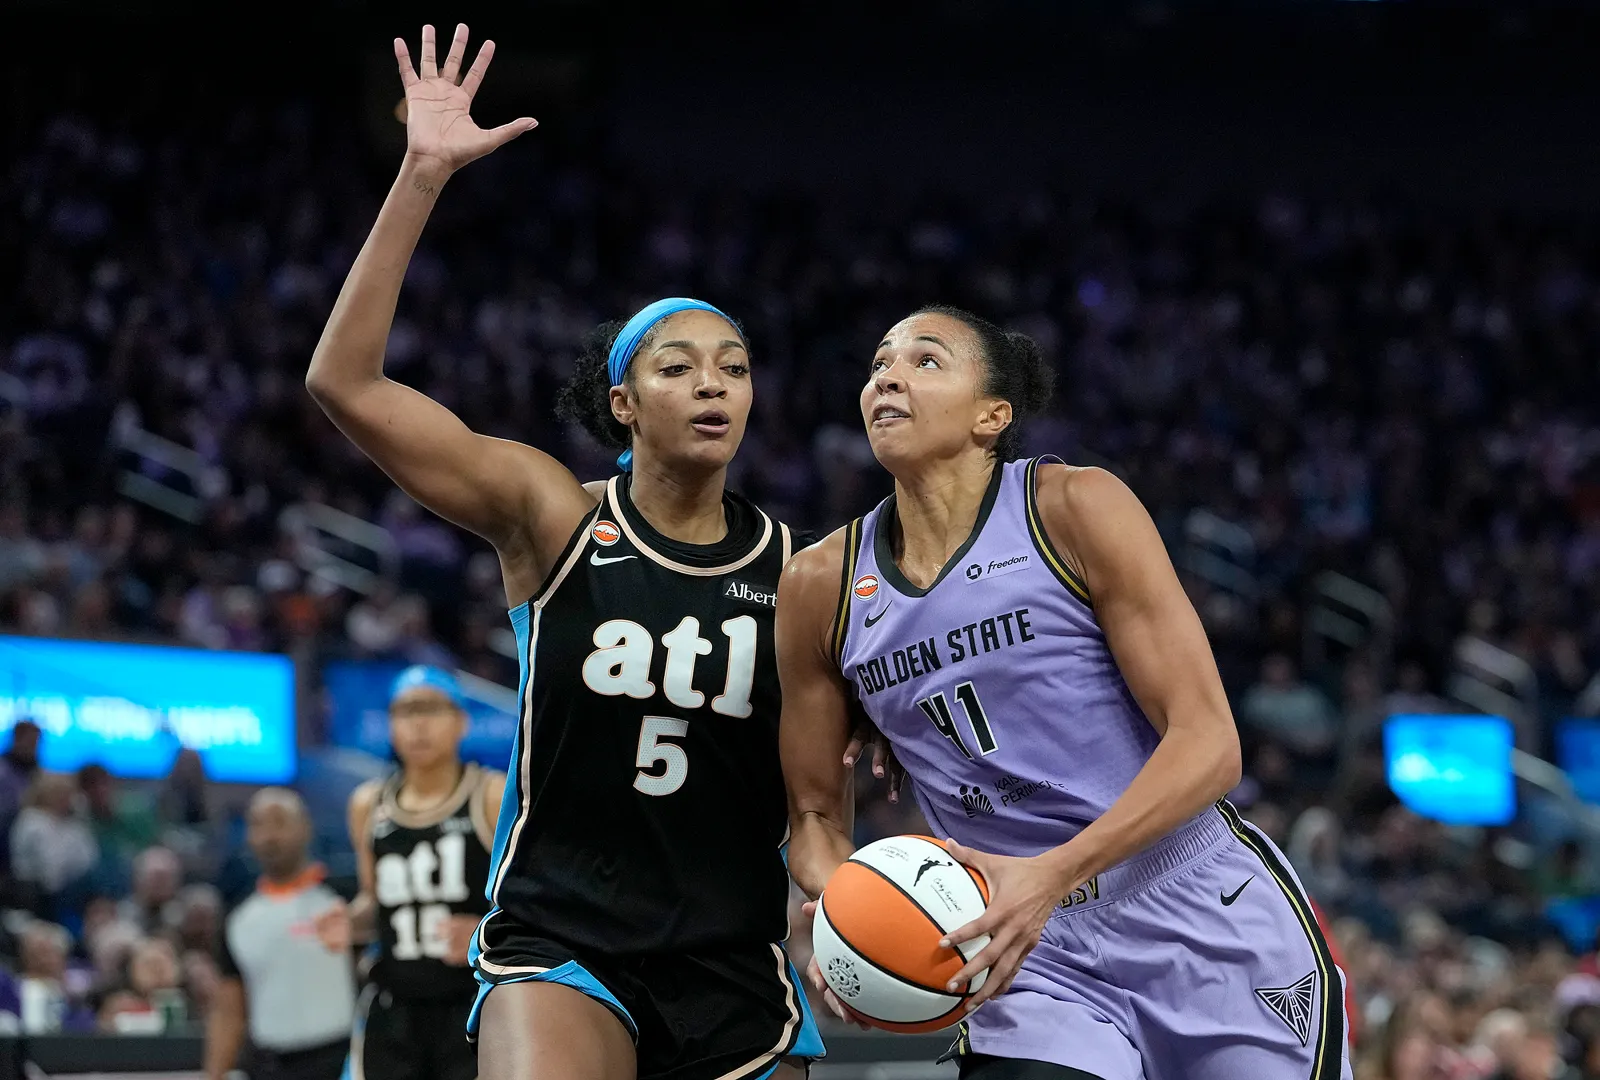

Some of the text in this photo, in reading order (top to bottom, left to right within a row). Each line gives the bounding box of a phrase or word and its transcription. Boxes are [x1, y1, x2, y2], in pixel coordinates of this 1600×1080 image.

[725, 581, 778, 607] Albert
[986, 555, 1028, 574] freedom
[582, 615, 757, 719] atl
[856, 608, 1035, 695] GOLDEN STATE
[633, 715, 689, 796] 5
[916, 680, 999, 759] 41
[993, 774, 1026, 793] KAIS
[376, 832, 470, 907] atl
